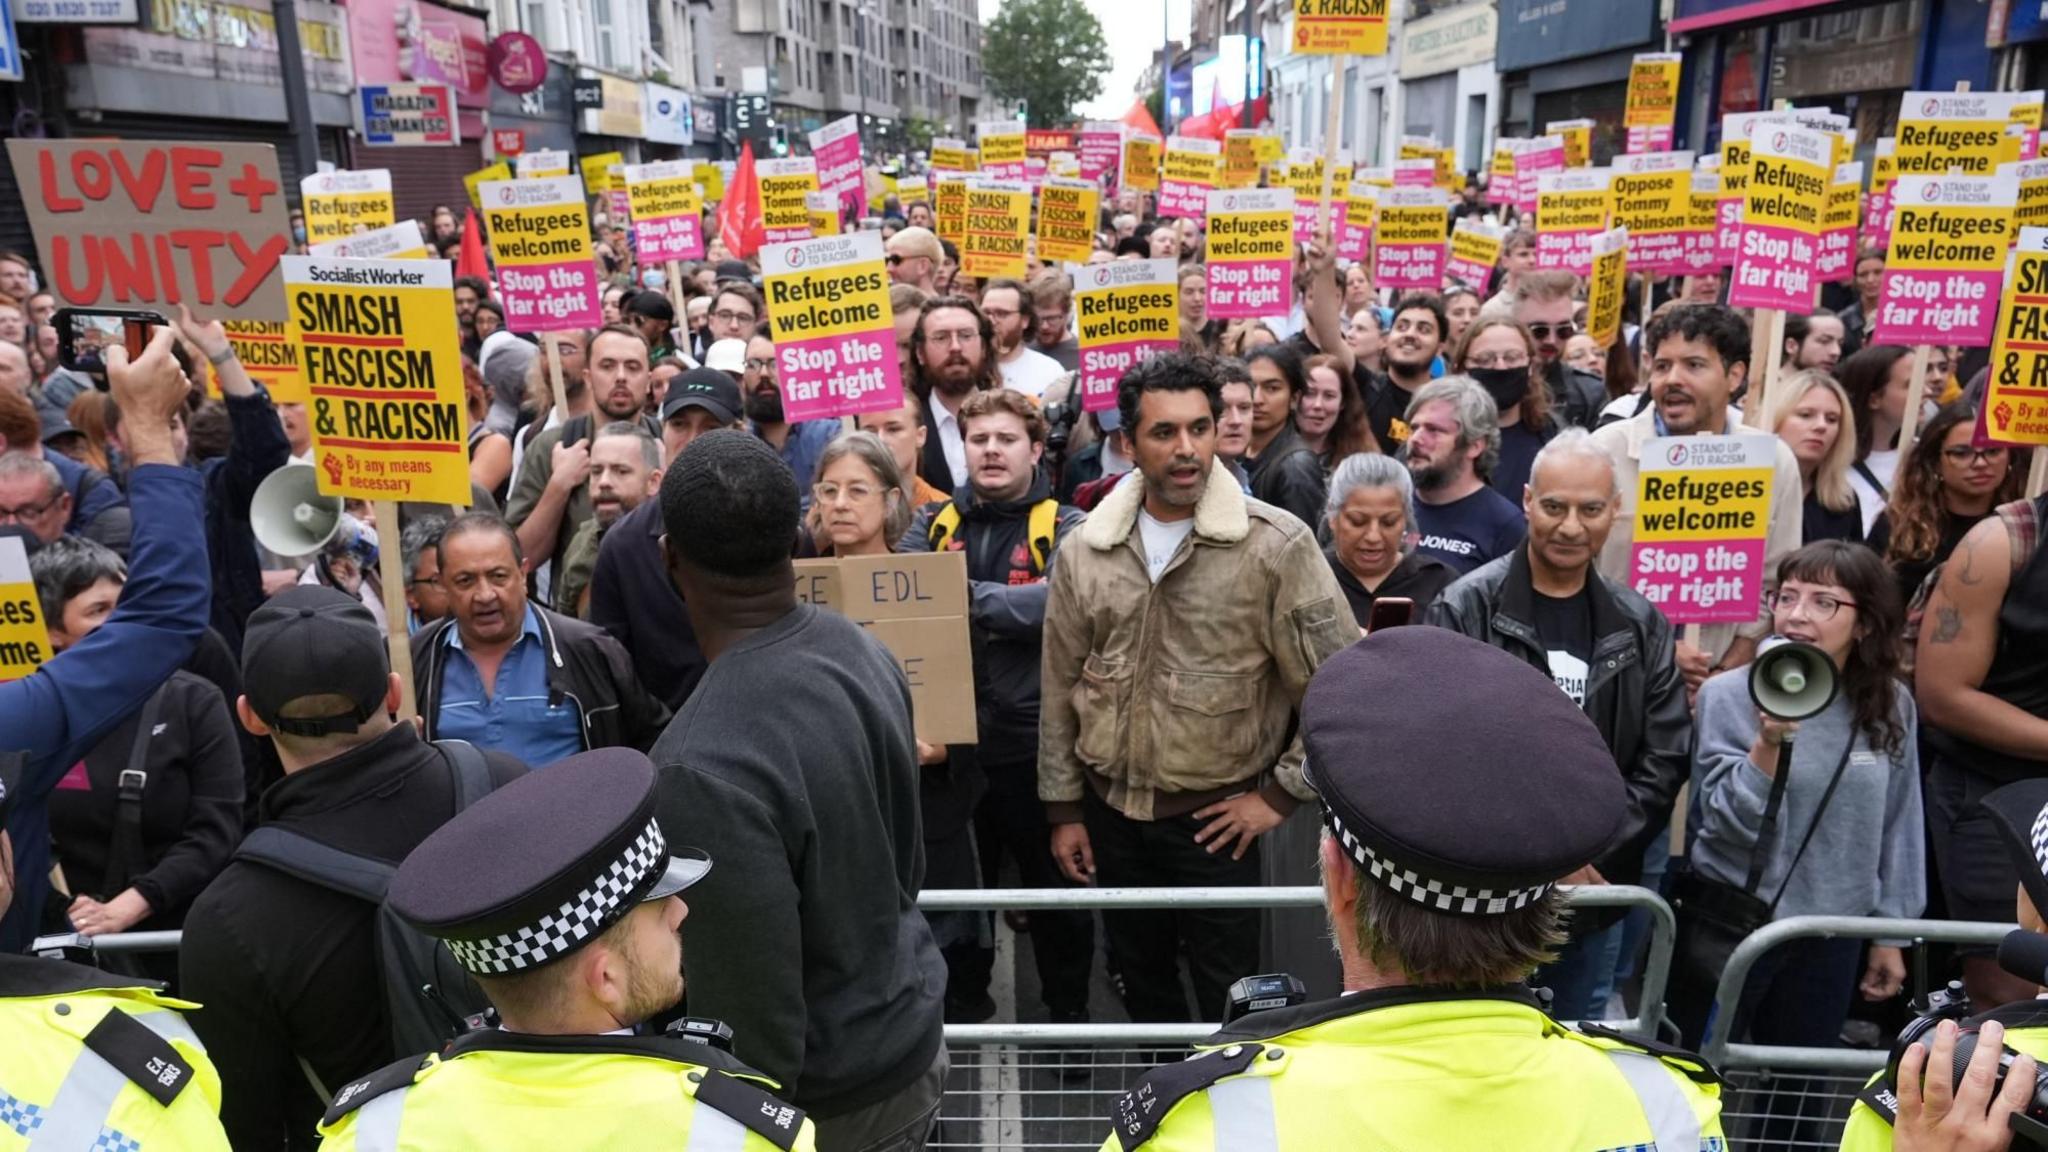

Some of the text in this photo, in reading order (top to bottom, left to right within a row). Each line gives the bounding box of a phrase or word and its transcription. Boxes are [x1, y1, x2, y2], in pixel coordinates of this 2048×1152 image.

[1319, 0, 1385, 16] RACISM
[374, 95, 438, 111] MAGAZIN
[1942, 98, 1985, 108] STAND UP
[1954, 107, 1987, 118] RACISM
[370, 116, 448, 134] ROMANESC
[1900, 125, 1999, 151] Refugees
[1167, 151, 1215, 168] Refugees
[1897, 151, 1988, 172] welcome
[40, 147, 222, 214] LOVE
[761, 178, 810, 193] Oppose
[1615, 177, 1675, 196] Oppose
[1753, 160, 1825, 196] Refugees
[631, 181, 692, 199] Refugees
[1042, 188, 1080, 204] SMASH
[1942, 192, 1991, 202] TO RACISM
[1943, 183, 1987, 193] STAND UP
[310, 199, 388, 217] Refugees
[634, 198, 691, 215] welcome
[764, 196, 805, 211] Tomm
[968, 192, 1010, 211] SMASH
[1541, 195, 1604, 210] Refugees
[1615, 197, 1671, 212] Tommy
[1751, 194, 1818, 224] welcome
[491, 212, 583, 235] Refugees
[765, 209, 809, 226] Robins
[966, 214, 1019, 233] FASCISM
[1041, 206, 1086, 222] FASCISM
[1381, 209, 1443, 226] Refugees
[1541, 211, 1600, 226] welcome
[1613, 214, 1685, 231] Robinson
[636, 218, 693, 238] Stop the
[1051, 225, 1091, 240] RACISM
[1211, 216, 1288, 236] Refugees
[1381, 226, 1440, 240] welcome
[1899, 210, 2006, 239] Refugees
[496, 236, 583, 258] welcome
[639, 234, 695, 253] far right
[806, 239, 852, 255] STAND UP
[965, 236, 1024, 254] & RACISM
[1212, 238, 1284, 255] welcome
[1539, 233, 1573, 251] Stop
[1744, 229, 1814, 265] Stop the
[1896, 239, 1996, 261] welcome
[808, 250, 858, 266] TO RACISM
[1378, 246, 1437, 263] Stop the
[1539, 249, 1593, 268] far righ
[50, 229, 289, 308] UNITY
[308, 265, 424, 285] Socialist Worker
[1210, 264, 1281, 287] Stop the
[1378, 262, 1435, 280] far right
[1739, 260, 1809, 296] far right
[502, 267, 586, 293] Stop the
[771, 272, 882, 304] Refugees
[1887, 274, 1986, 303] Stop the
[505, 291, 589, 318] far right
[1082, 291, 1173, 316] Refugees
[1210, 286, 1280, 307] far right
[296, 291, 403, 336] SMASH
[777, 302, 880, 333] welcome
[1883, 302, 1980, 332] far right
[1084, 316, 1169, 339] welcome
[781, 338, 883, 374] Stop the
[1085, 344, 1156, 372] Stop th
[304, 345, 436, 390] FASCISM
[1999, 352, 2020, 386] &
[786, 366, 886, 402] far right
[1086, 374, 1115, 395] far
[315, 397, 461, 442] & RACISM
[2018, 402, 2033, 420] By
[1690, 442, 1743, 455] STAND UP
[346, 455, 433, 474] By any means
[1691, 453, 1747, 466] TO RACISM
[348, 476, 412, 495] necessary
[1644, 475, 1765, 506] Refugees
[1642, 507, 1756, 531] welcome
[1637, 545, 1749, 579] Stop the
[872, 570, 933, 602] EDL
[1634, 576, 1744, 608] far right
[145, 1056, 167, 1075] EA
[760, 1101, 778, 1117] CE
